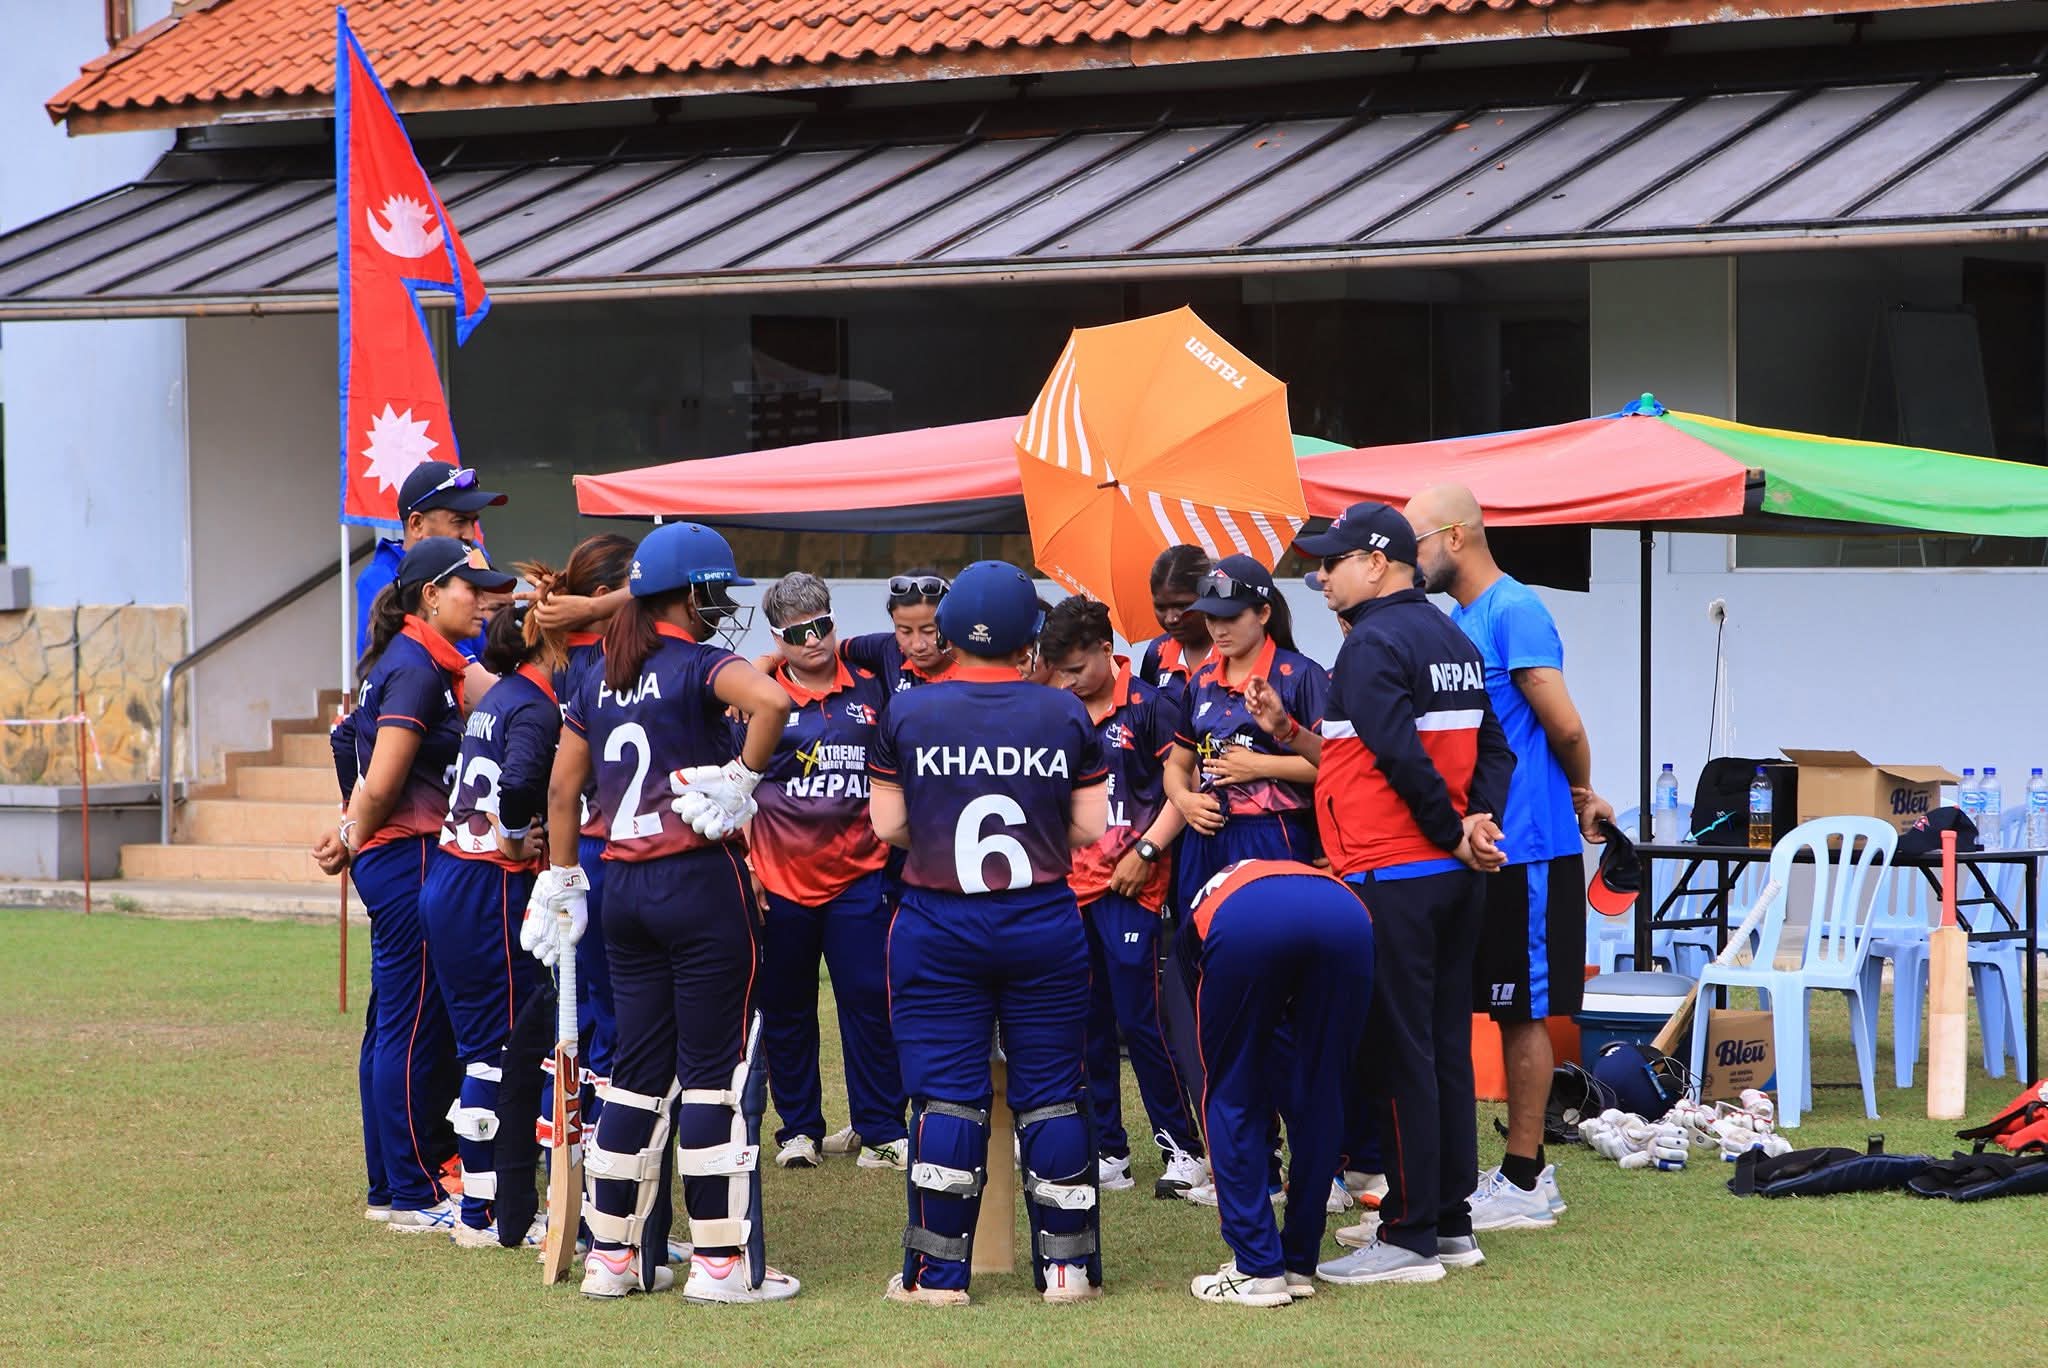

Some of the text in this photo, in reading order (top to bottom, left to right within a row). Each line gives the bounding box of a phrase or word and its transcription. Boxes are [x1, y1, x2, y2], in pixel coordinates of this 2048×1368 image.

[598, 672, 661, 709] PUJA
[1429, 661, 1484, 692] NEPAL
[916, 746, 1069, 779] KHADKA
[604, 721, 664, 841] 2
[785, 774, 870, 798] NEPAL
[954, 794, 1033, 894] 6
[1715, 1040, 1766, 1067] Bleu
[736, 1151, 752, 1165] SM
